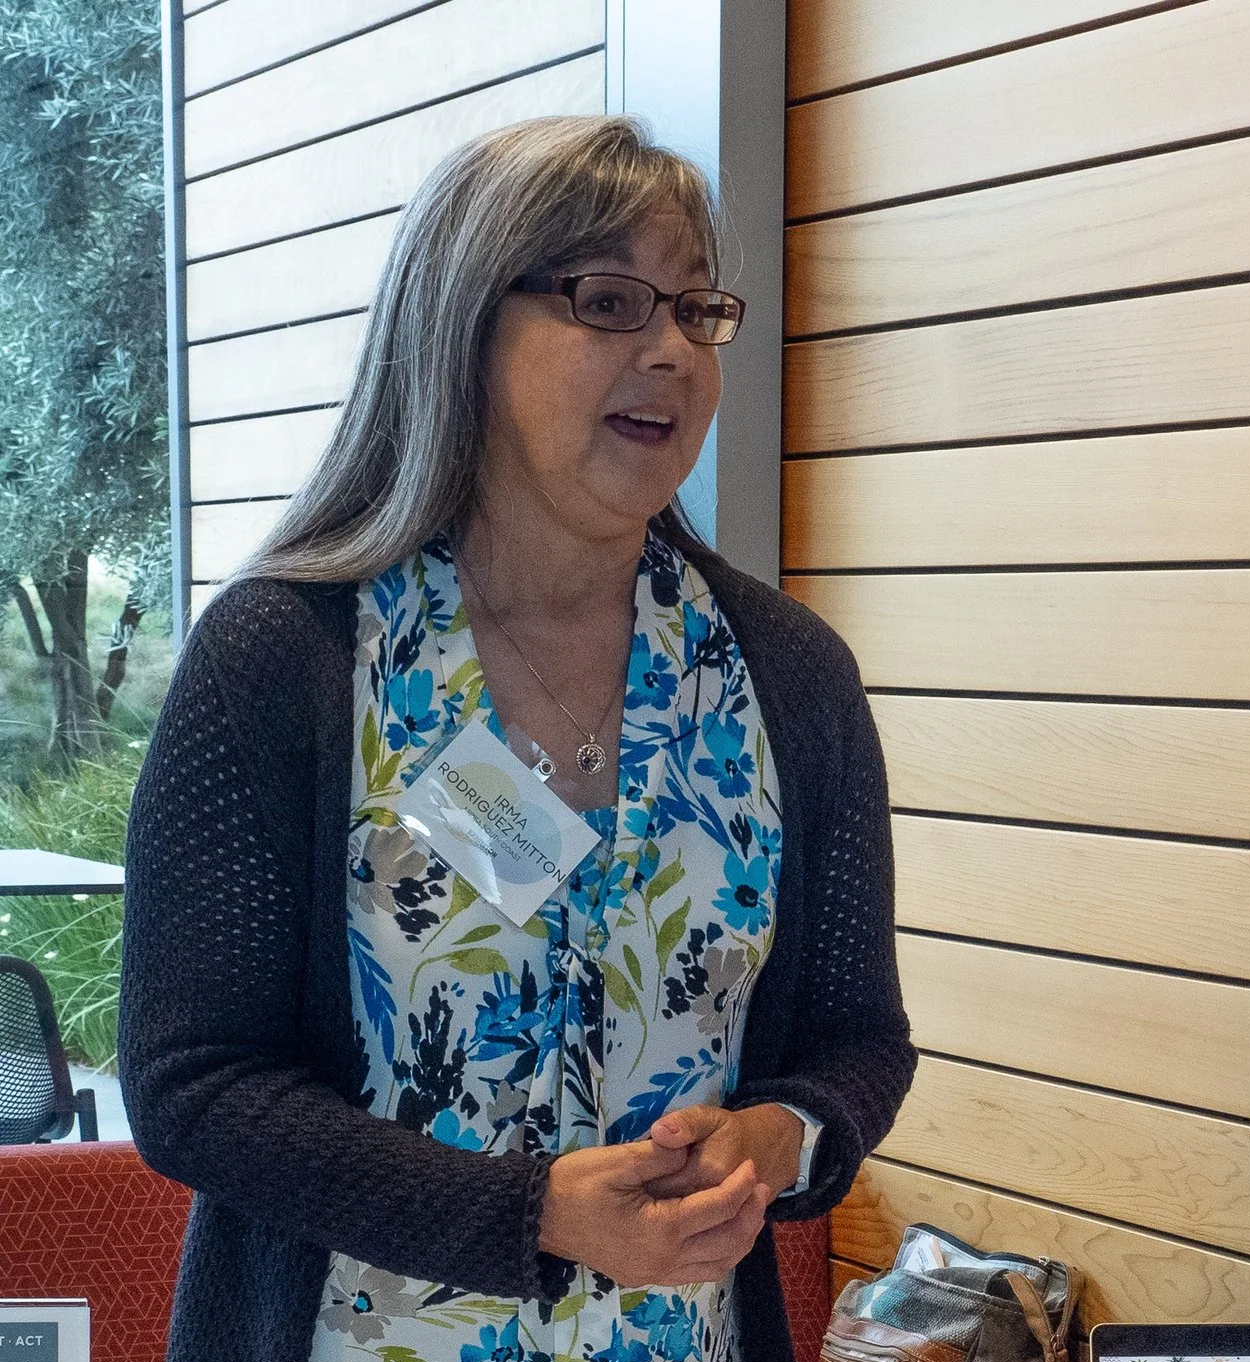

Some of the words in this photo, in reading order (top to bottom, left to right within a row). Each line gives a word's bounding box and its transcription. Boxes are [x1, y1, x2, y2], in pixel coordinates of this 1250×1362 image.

[437, 761, 514, 837] RODRIGUEZ
[512, 833, 567, 883] MITTON
[494, 794, 528, 830] IRMA
[15, 1335, 43, 1346] ACT
